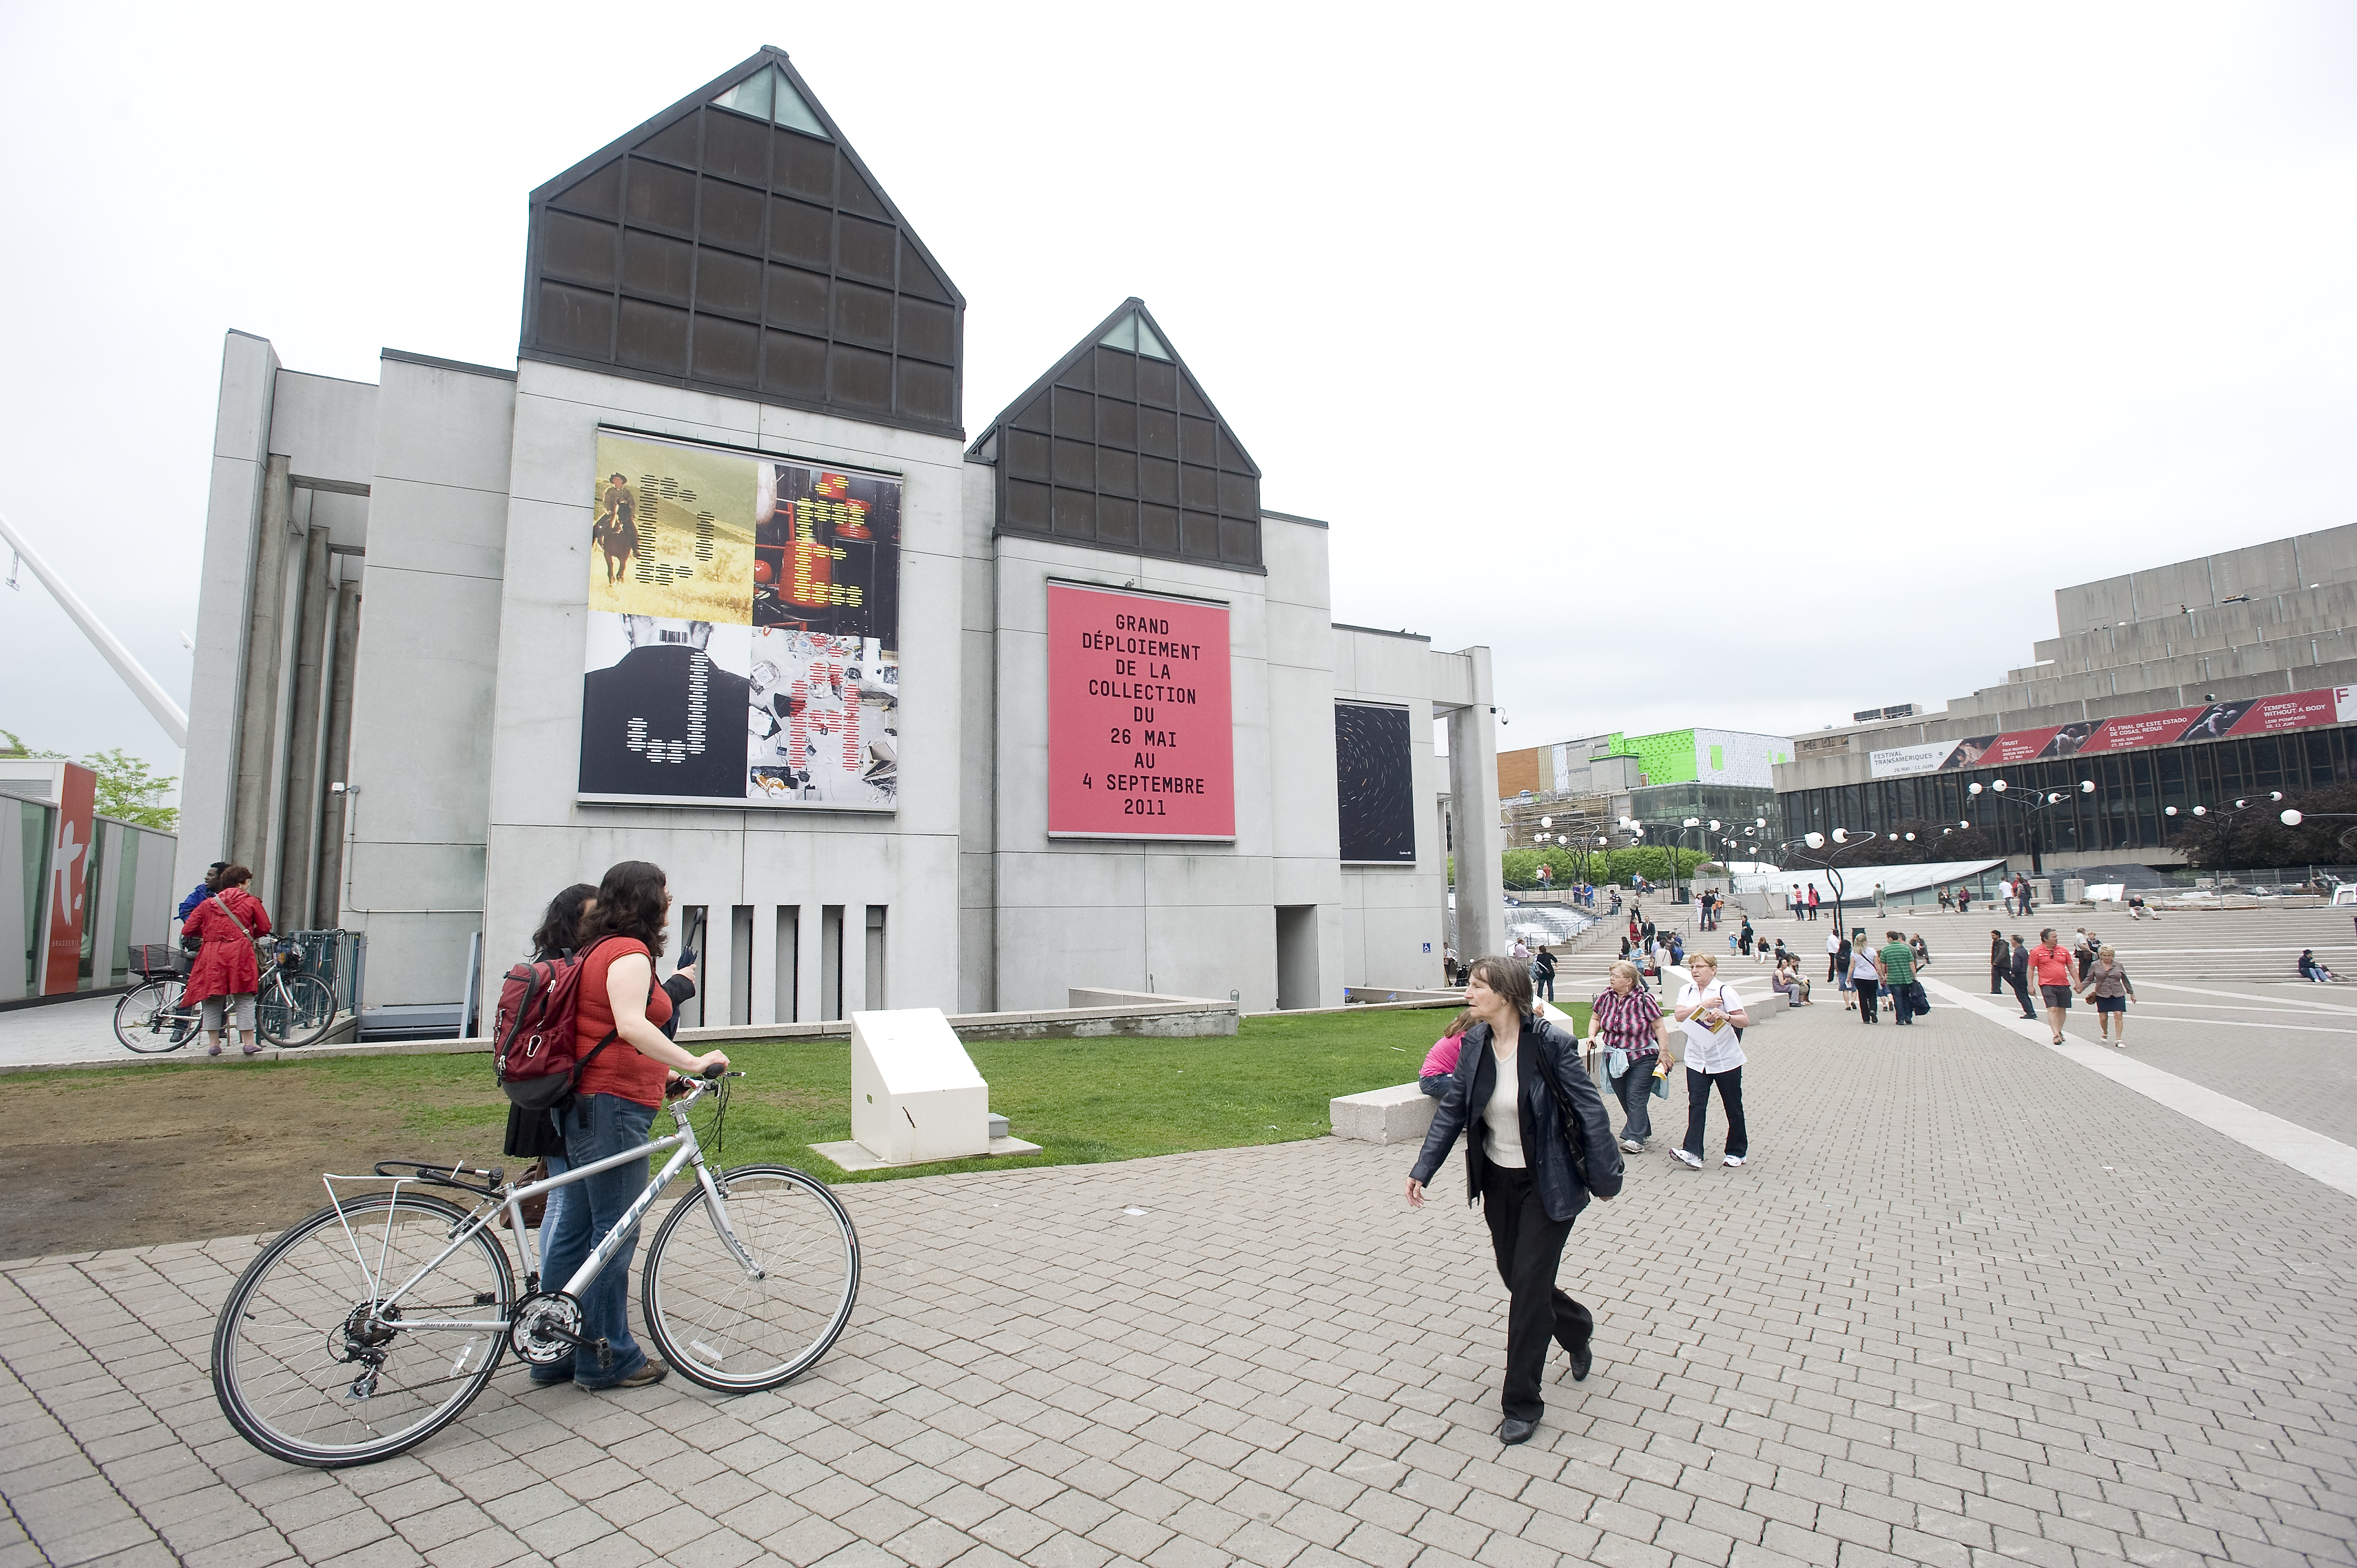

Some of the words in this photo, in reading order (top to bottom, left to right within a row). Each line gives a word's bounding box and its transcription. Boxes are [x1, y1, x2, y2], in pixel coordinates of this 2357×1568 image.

[1116, 614, 1169, 635] GRAND
[1083, 630, 1200, 661] DÉPLOIEMENT
[1116, 659, 1136, 676] DE
[1150, 662, 1170, 680] LA
[1089, 679, 1196, 704] COLLECTION
[2335, 688, 2349, 703] F
[1134, 706, 1154, 723] DU
[2263, 702, 2298, 711] TEMPEST:
[2263, 708, 2296, 717] WITHOUT
[1111, 728, 1131, 744] 26
[1145, 730, 1176, 747] MAI
[1134, 752, 1155, 769] AU
[1874, 751, 1902, 759] FESTIVAL
[1875, 752, 1933, 766] TRANSAMÉRIQUES
[1083, 773, 1092, 790] 4
[1107, 773, 1205, 794] SEPTEMBRE
[1124, 798, 1166, 816] 2011
[598, 1173, 666, 1262] FUJI
[727, 1231, 753, 1261] FUJI
